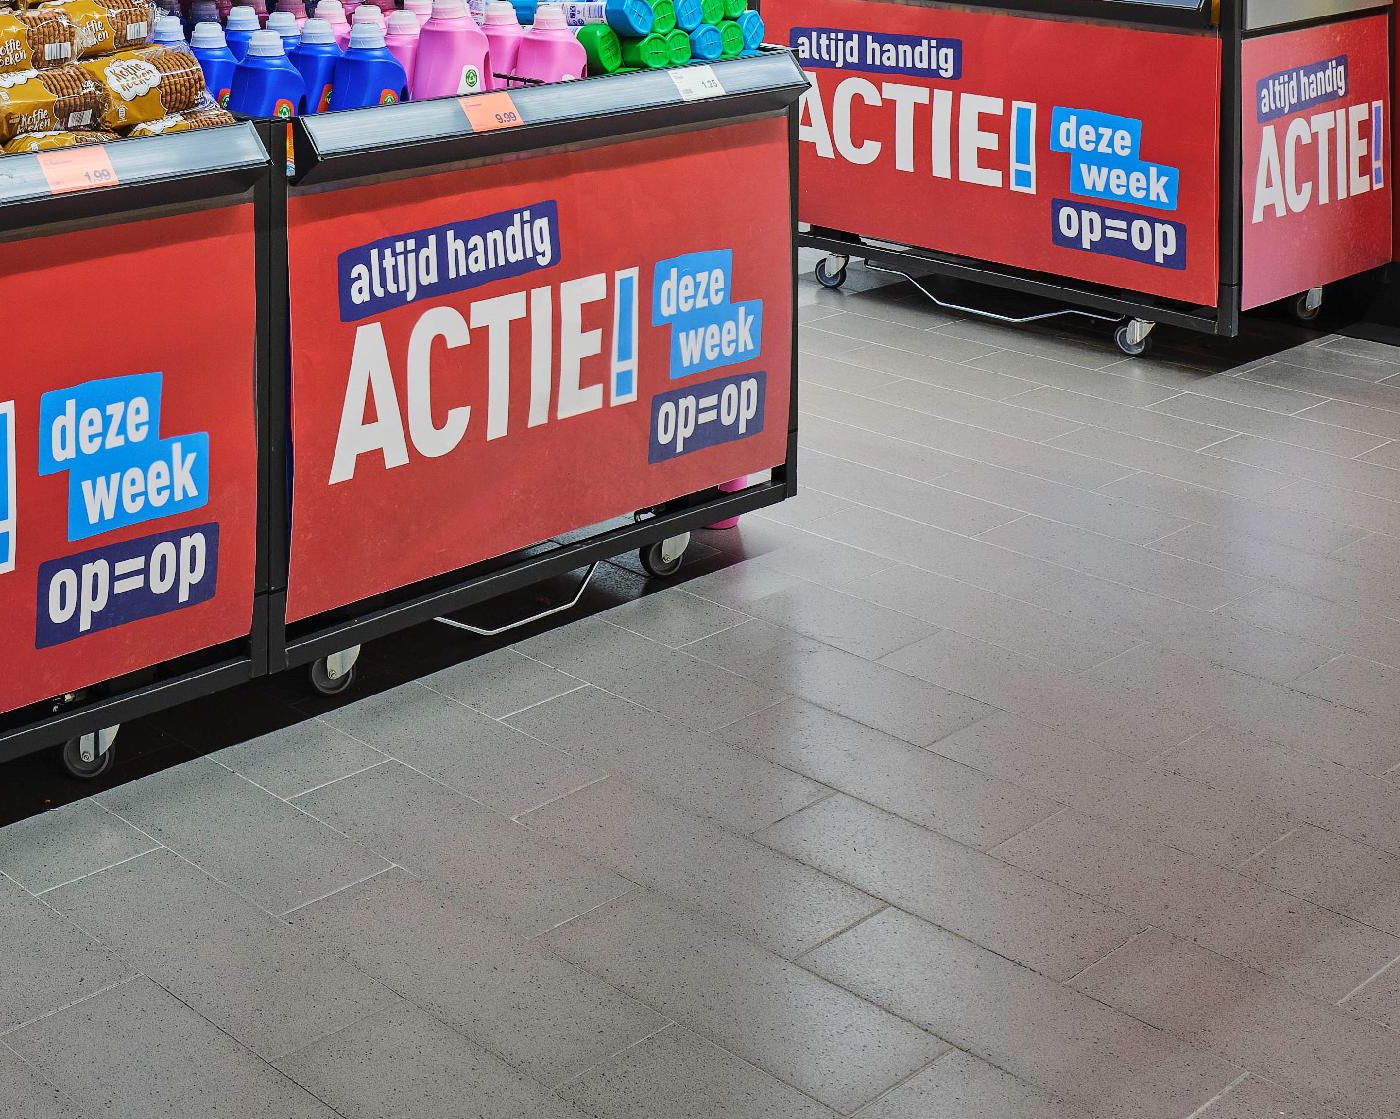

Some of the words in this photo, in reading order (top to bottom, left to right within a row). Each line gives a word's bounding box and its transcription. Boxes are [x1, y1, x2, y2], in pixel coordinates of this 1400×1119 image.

[797, 30, 860, 67] altijd
[865, 37, 955, 78] handig
[21, 109, 49, 125] Koffie
[495, 111, 517, 123] 9.99
[1261, 72, 1298, 114] altijd
[1300, 59, 1346, 102] handig
[799, 73, 1037, 195] ACTIE!
[1058, 115, 1133, 155] deze
[1252, 99, 1384, 224] ACTIE!
[85, 168, 111, 183] 1.99
[1079, 163, 1170, 205] week
[350, 239, 438, 305] altijd
[447, 209, 552, 278] handig
[1058, 204, 1178, 264] op=op
[660, 266, 725, 317] deze
[679, 305, 756, 367] week
[328, 266, 640, 486] ACTIE!
[51, 389, 150, 463] deze
[657, 377, 758, 453] op=op
[82, 440, 200, 526] week
[48, 530, 206, 632] op=op
